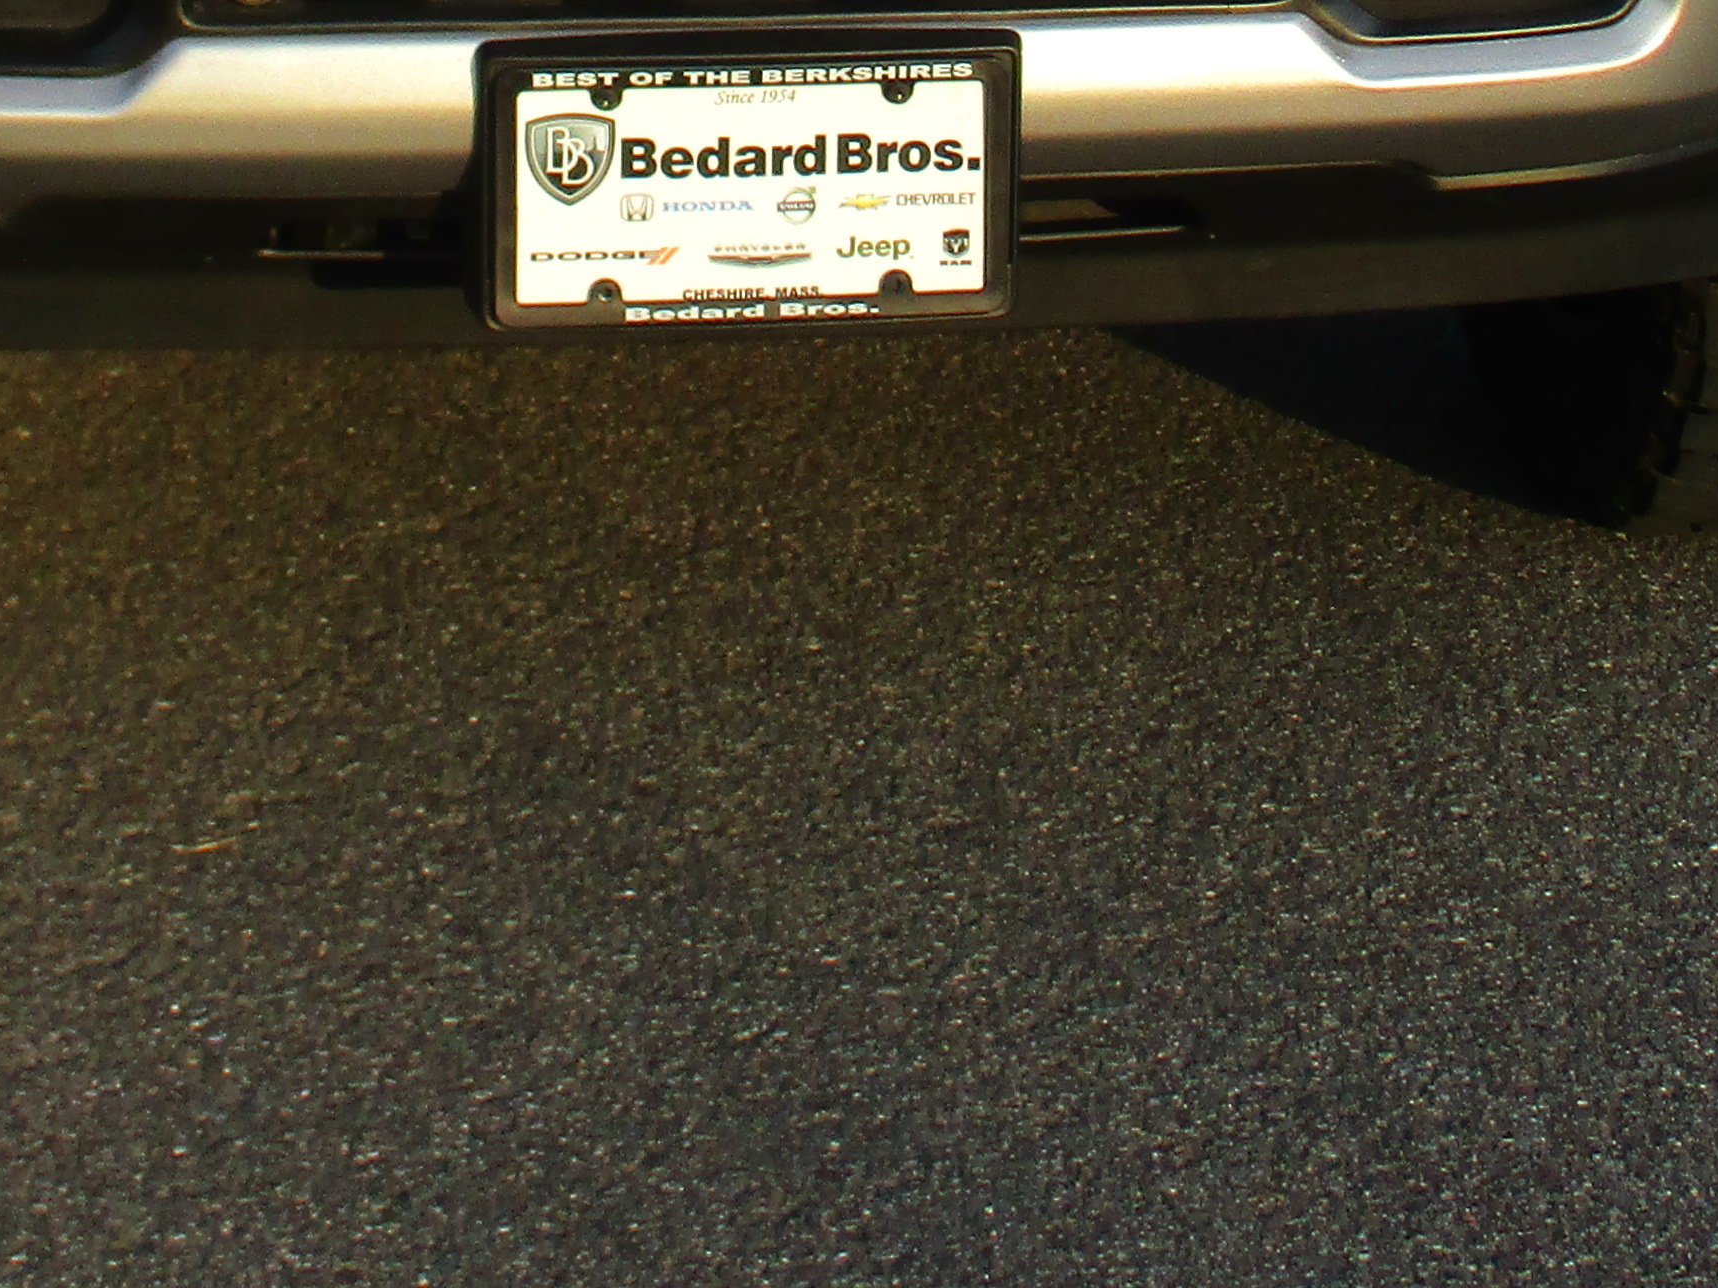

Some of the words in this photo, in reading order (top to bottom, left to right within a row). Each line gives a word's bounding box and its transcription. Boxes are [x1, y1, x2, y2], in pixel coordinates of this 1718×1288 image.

[531, 71, 620, 89] BEST
[628, 71, 674, 87] OF
[682, 70, 751, 86] THE
[760, 62, 974, 84] BERKSHIRES
[713, 90, 755, 106] Since
[760, 88, 797, 104] 1954
[620, 136, 827, 180] Bedard
[836, 132, 982, 176] Bros.
[662, 200, 754, 213] HONDA
[895, 191, 977, 207] CHEVROLET
[530, 250, 663, 263] DODGE
[835, 235, 911, 261] Jeep
[624, 304, 765, 322] Bedard
[779, 301, 881, 319] Bros.
